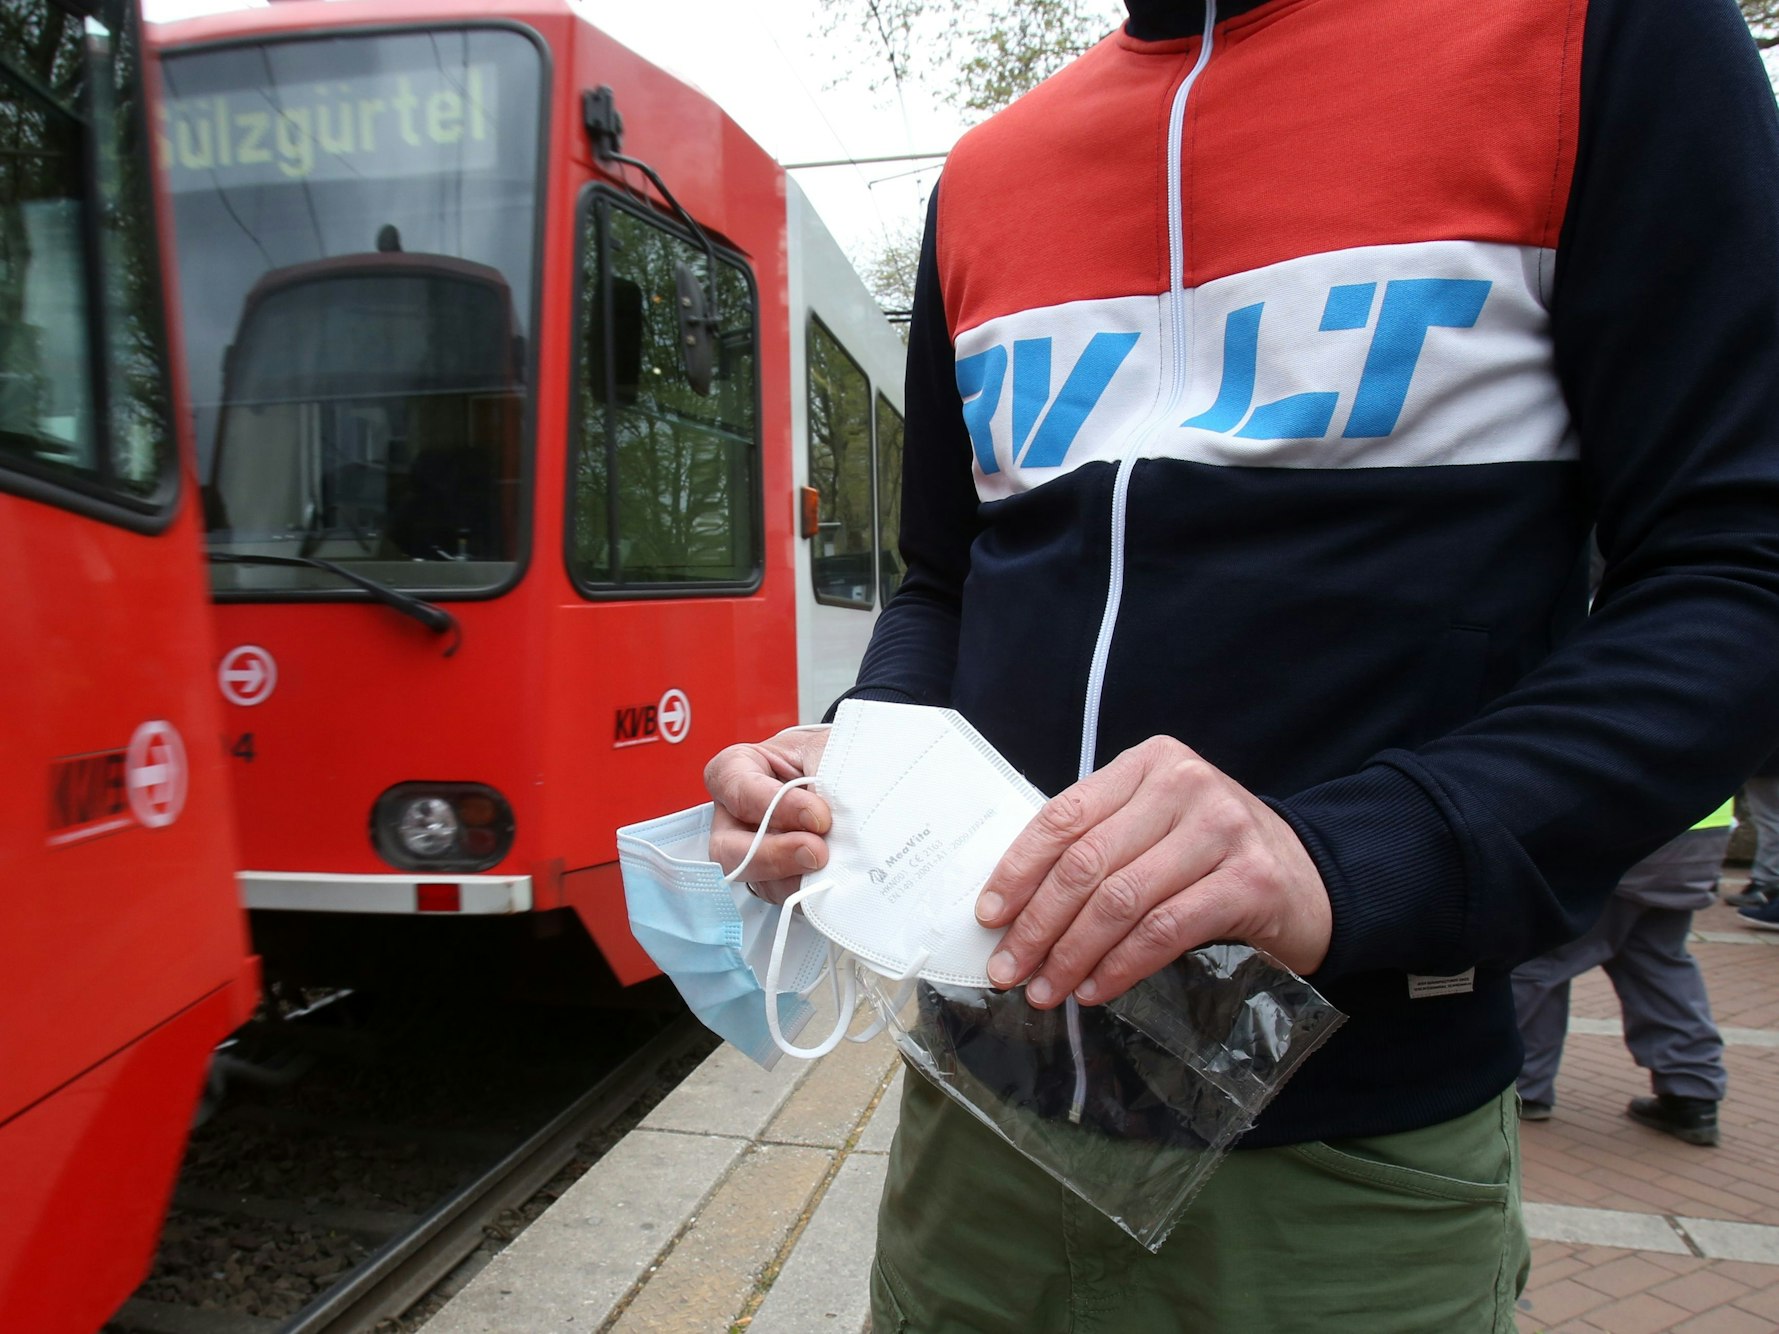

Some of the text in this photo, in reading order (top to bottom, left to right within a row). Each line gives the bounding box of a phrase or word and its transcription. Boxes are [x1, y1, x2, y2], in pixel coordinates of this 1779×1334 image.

[614, 705, 657, 741] KVB
[885, 828, 931, 867] MeaVita
[908, 854, 925, 868] CE
